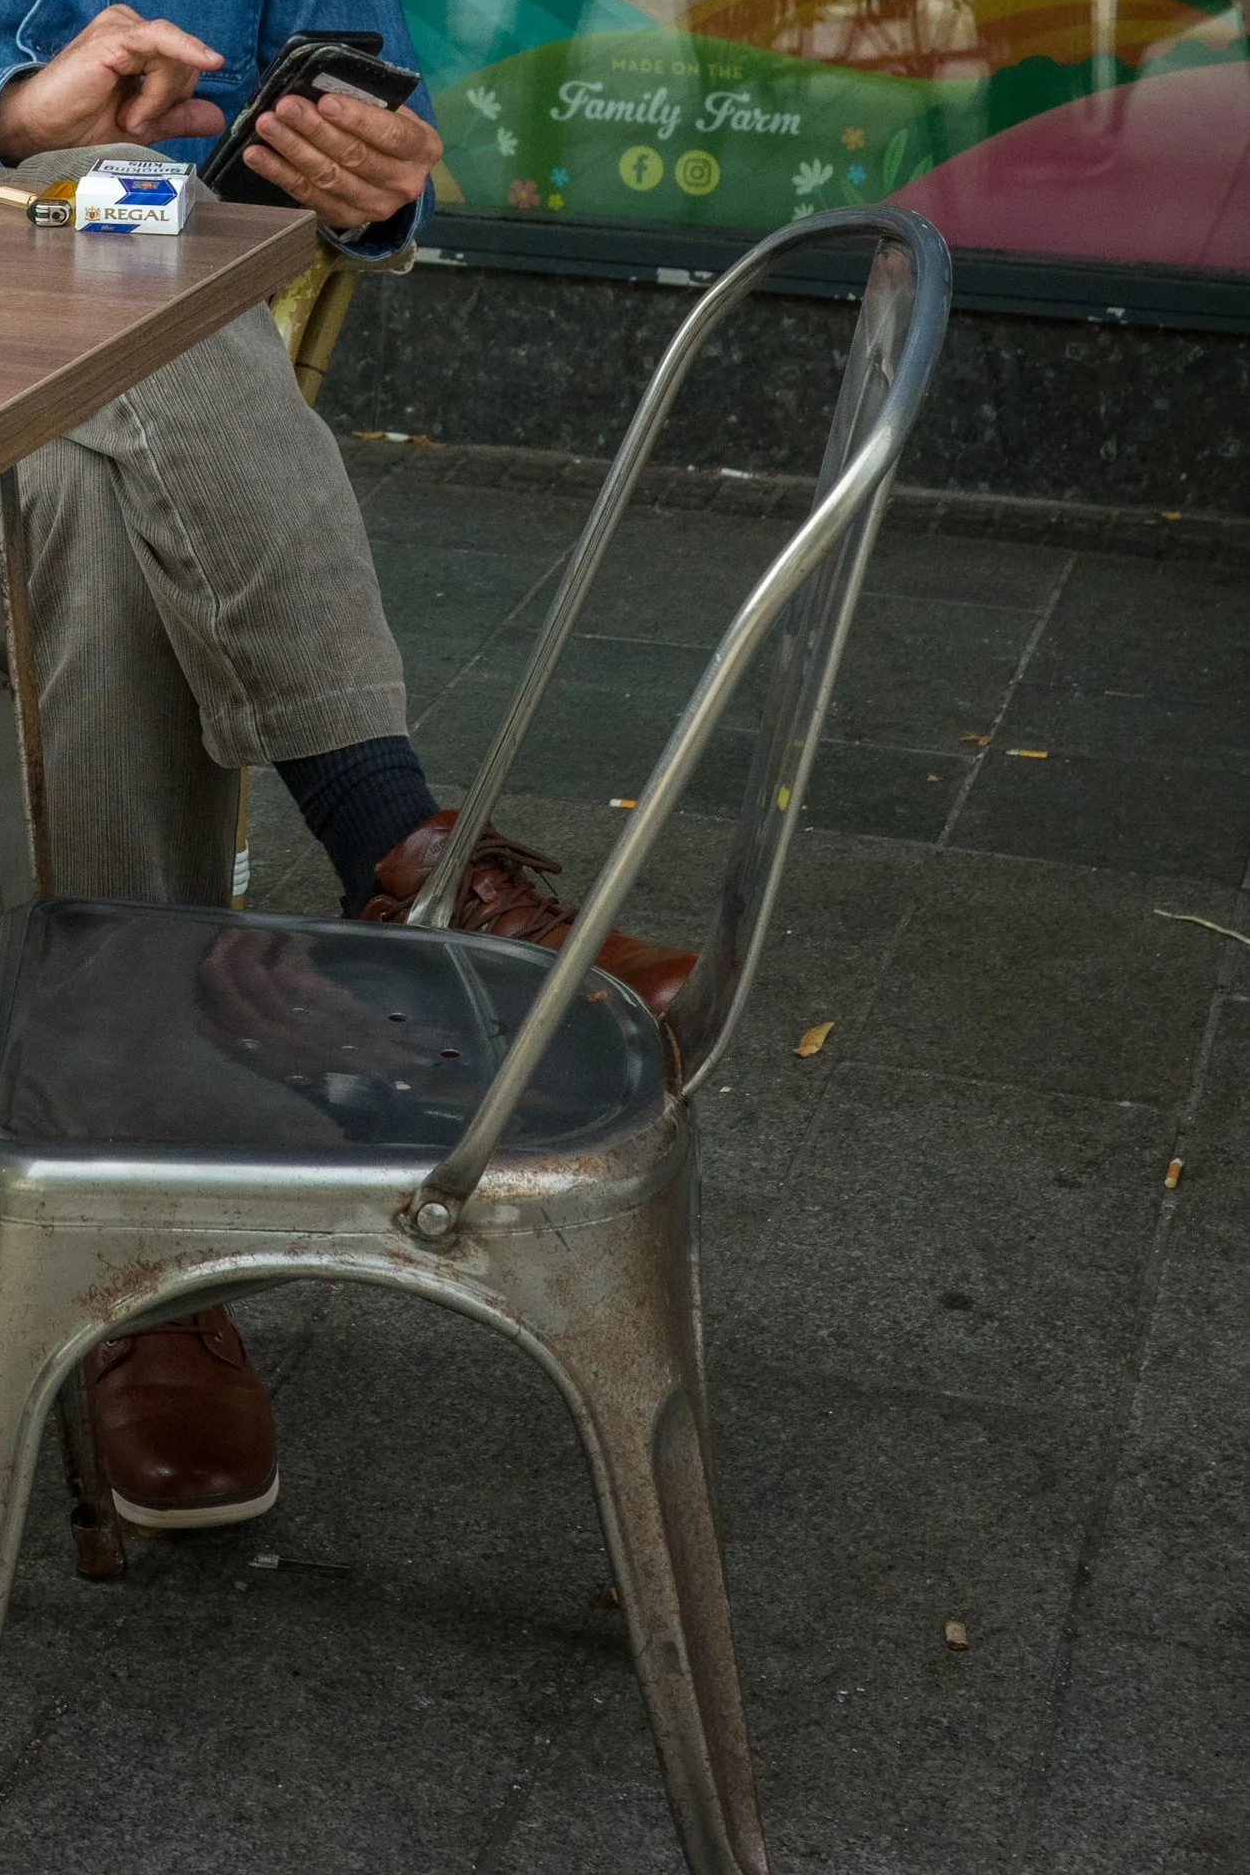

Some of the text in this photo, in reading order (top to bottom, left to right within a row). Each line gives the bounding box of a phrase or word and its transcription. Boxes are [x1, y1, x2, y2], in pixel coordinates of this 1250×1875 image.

[610, 58, 743, 80] MADE ON THE
[549, 80, 802, 141] Family Farm
[104, 208, 170, 222] REGAL
